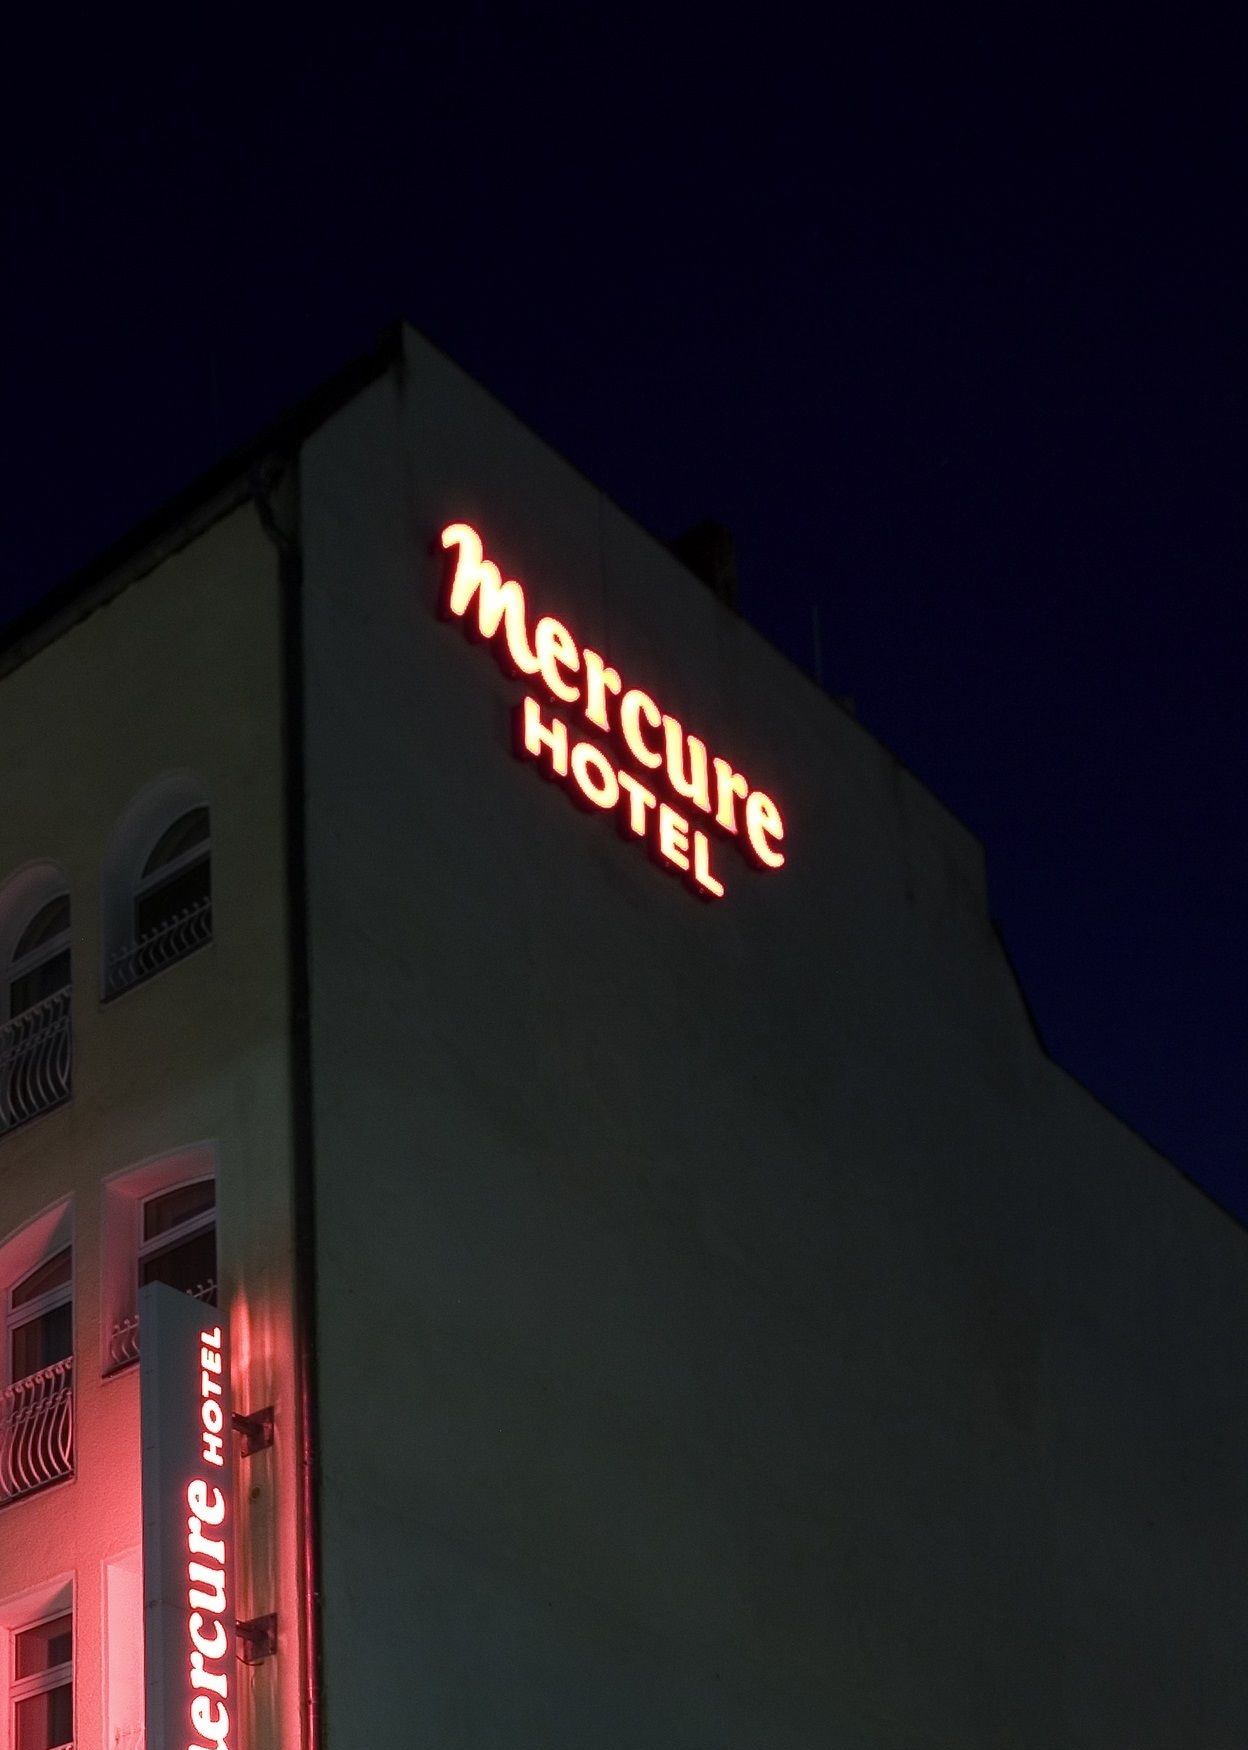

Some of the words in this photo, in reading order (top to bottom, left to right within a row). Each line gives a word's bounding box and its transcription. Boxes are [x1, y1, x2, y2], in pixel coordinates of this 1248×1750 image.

[442, 522, 785, 869] Mercure
[523, 695, 725, 898] HOTEL
[200, 1326, 224, 1467] HOTEL
